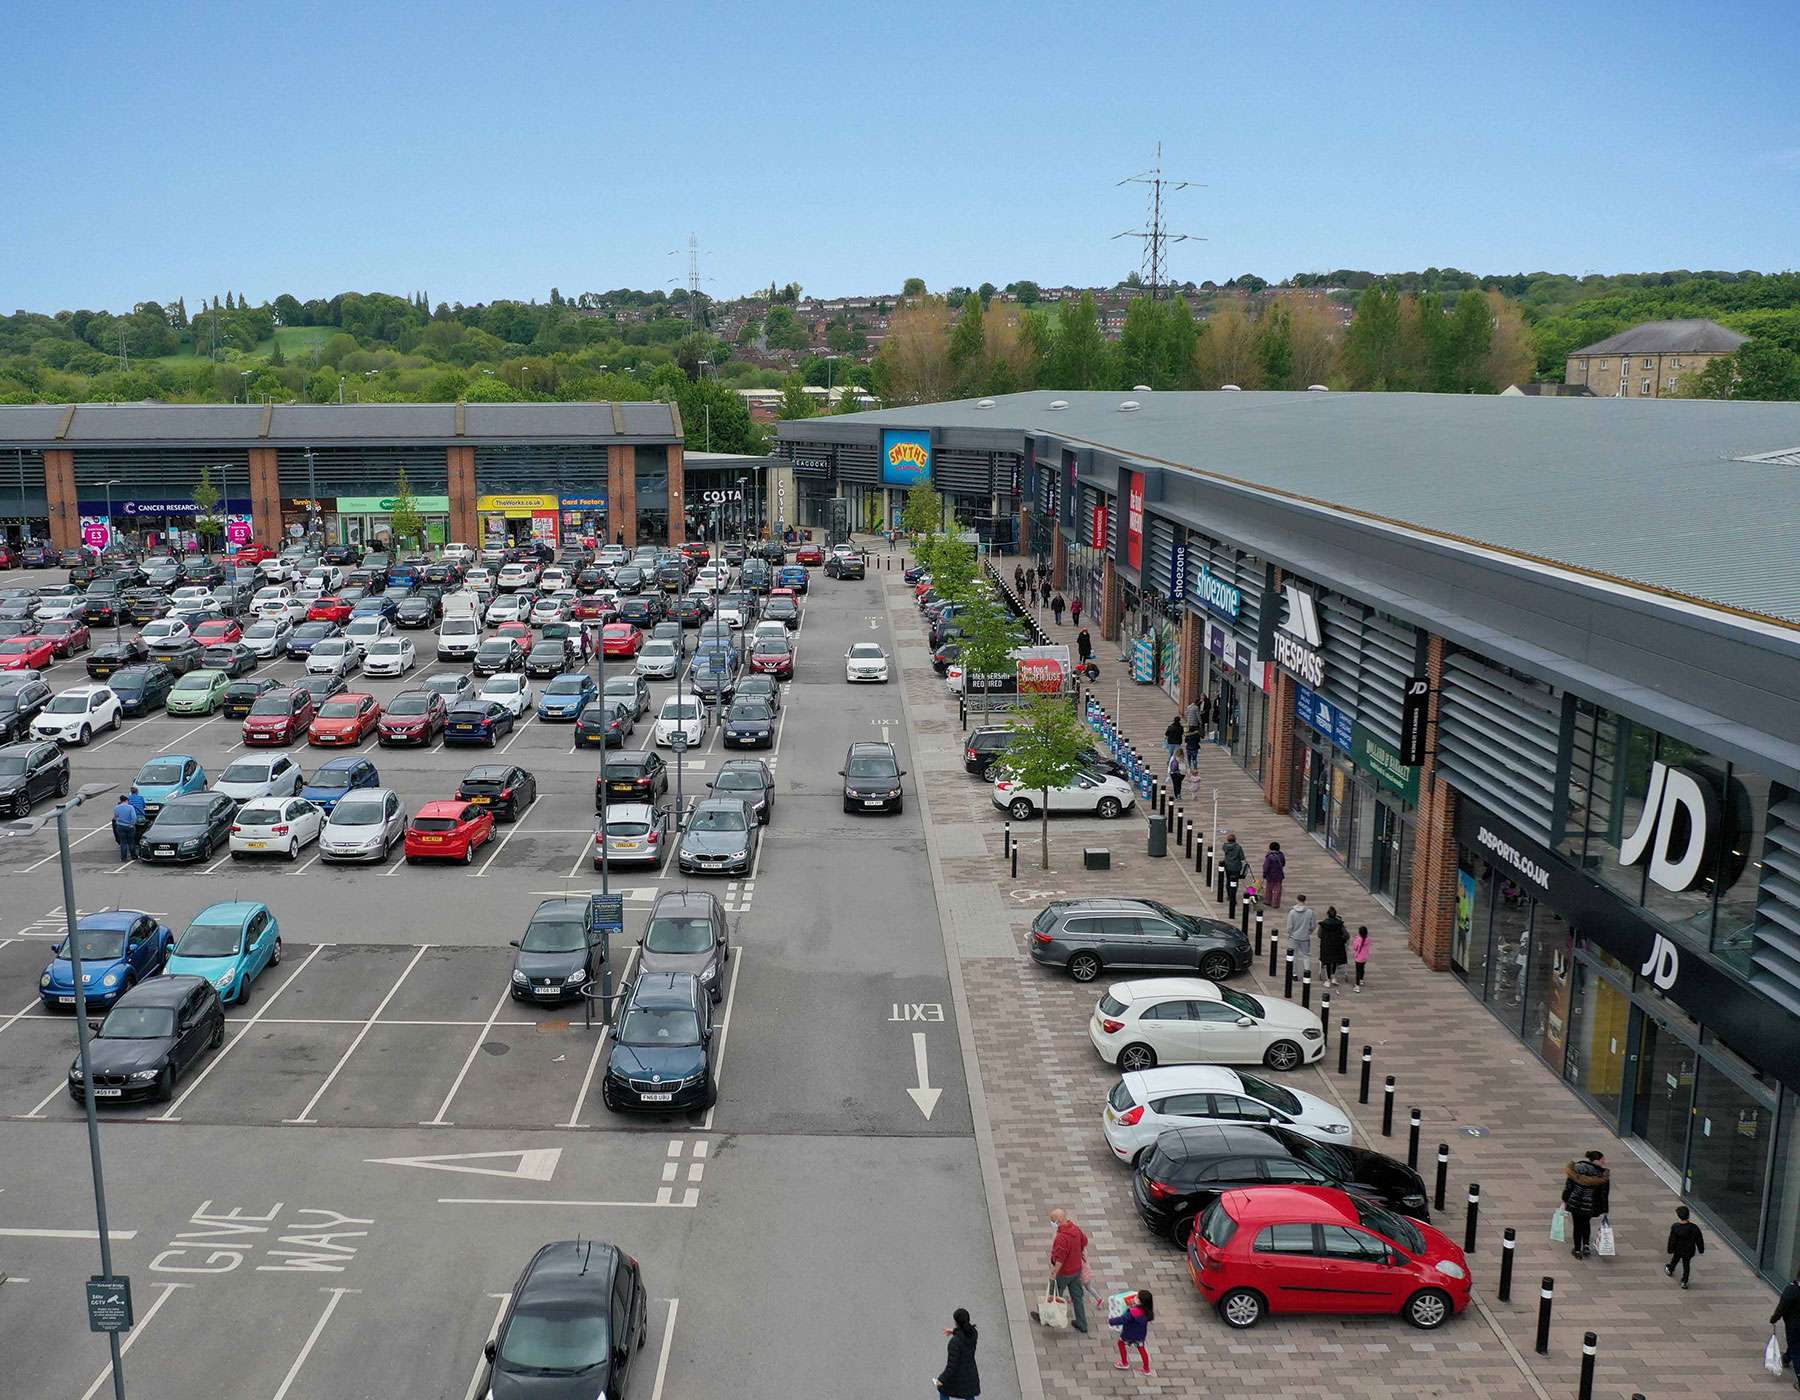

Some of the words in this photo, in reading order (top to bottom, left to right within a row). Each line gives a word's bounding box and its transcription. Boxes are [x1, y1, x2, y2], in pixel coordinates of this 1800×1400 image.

[888, 443, 927, 468] SMYTHS
[138, 504, 165, 512] CANCER
[166, 503, 200, 511] RESEARCH
[580, 499, 605, 507] Factory
[703, 490, 742, 503] COSTA
[91, 531, 102, 540] £3
[234, 529, 245, 537] £3
[1173, 547, 1185, 598] shoezone
[1196, 563, 1240, 616] shoezone
[1273, 631, 1324, 688] TRESPASS
[1408, 682, 1428, 696] JD
[1619, 761, 1707, 892] JD
[1477, 825, 1550, 891] JDSPORTS.CO.UK
[1641, 933, 1680, 990] JD
[887, 1003, 945, 1022] EXIT
[149, 1200, 285, 1273] GIVE
[255, 1208, 376, 1272] WAY
